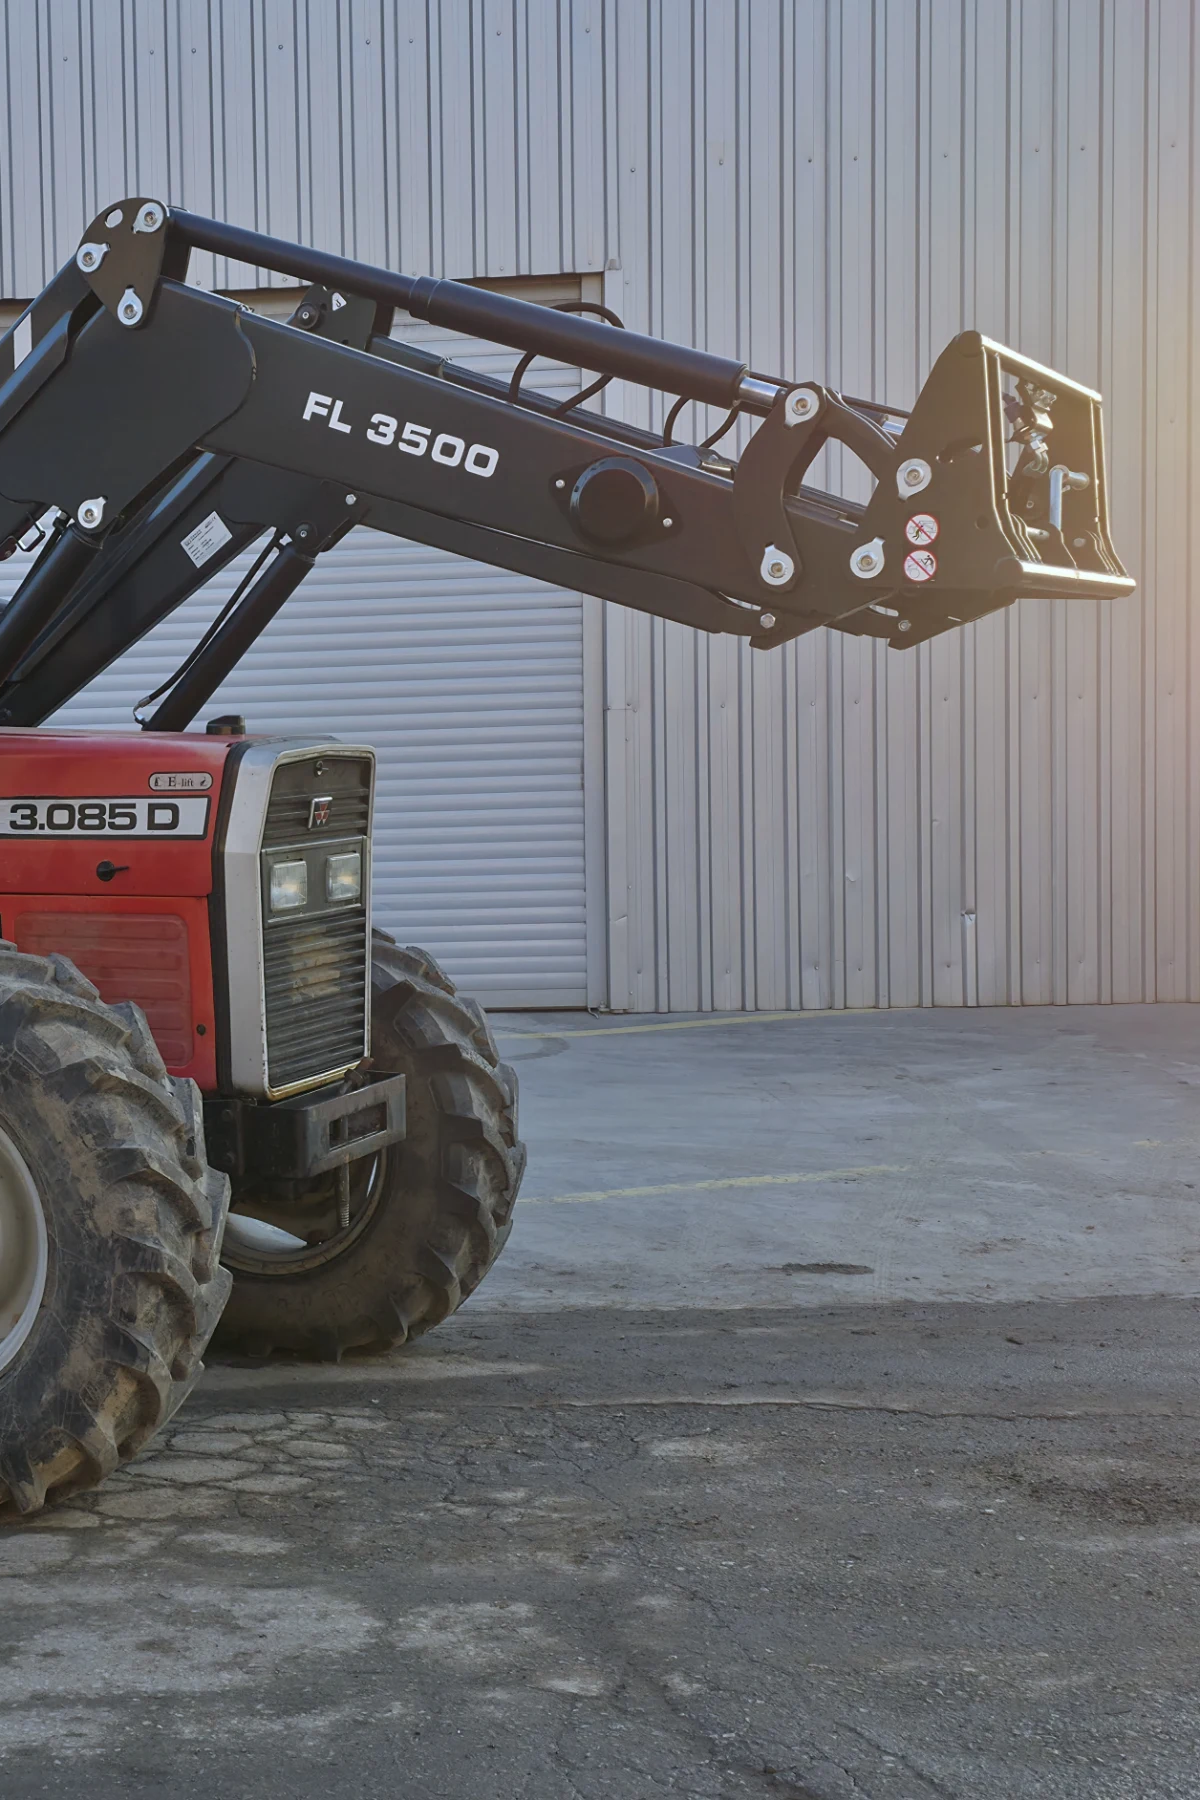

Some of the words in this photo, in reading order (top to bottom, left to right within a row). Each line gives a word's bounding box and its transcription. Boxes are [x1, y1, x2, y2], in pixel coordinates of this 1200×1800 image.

[302, 391, 352, 434] FL
[366, 413, 500, 478] 3500
[9, 803, 137, 831] 3.085
[147, 803, 180, 831] D
